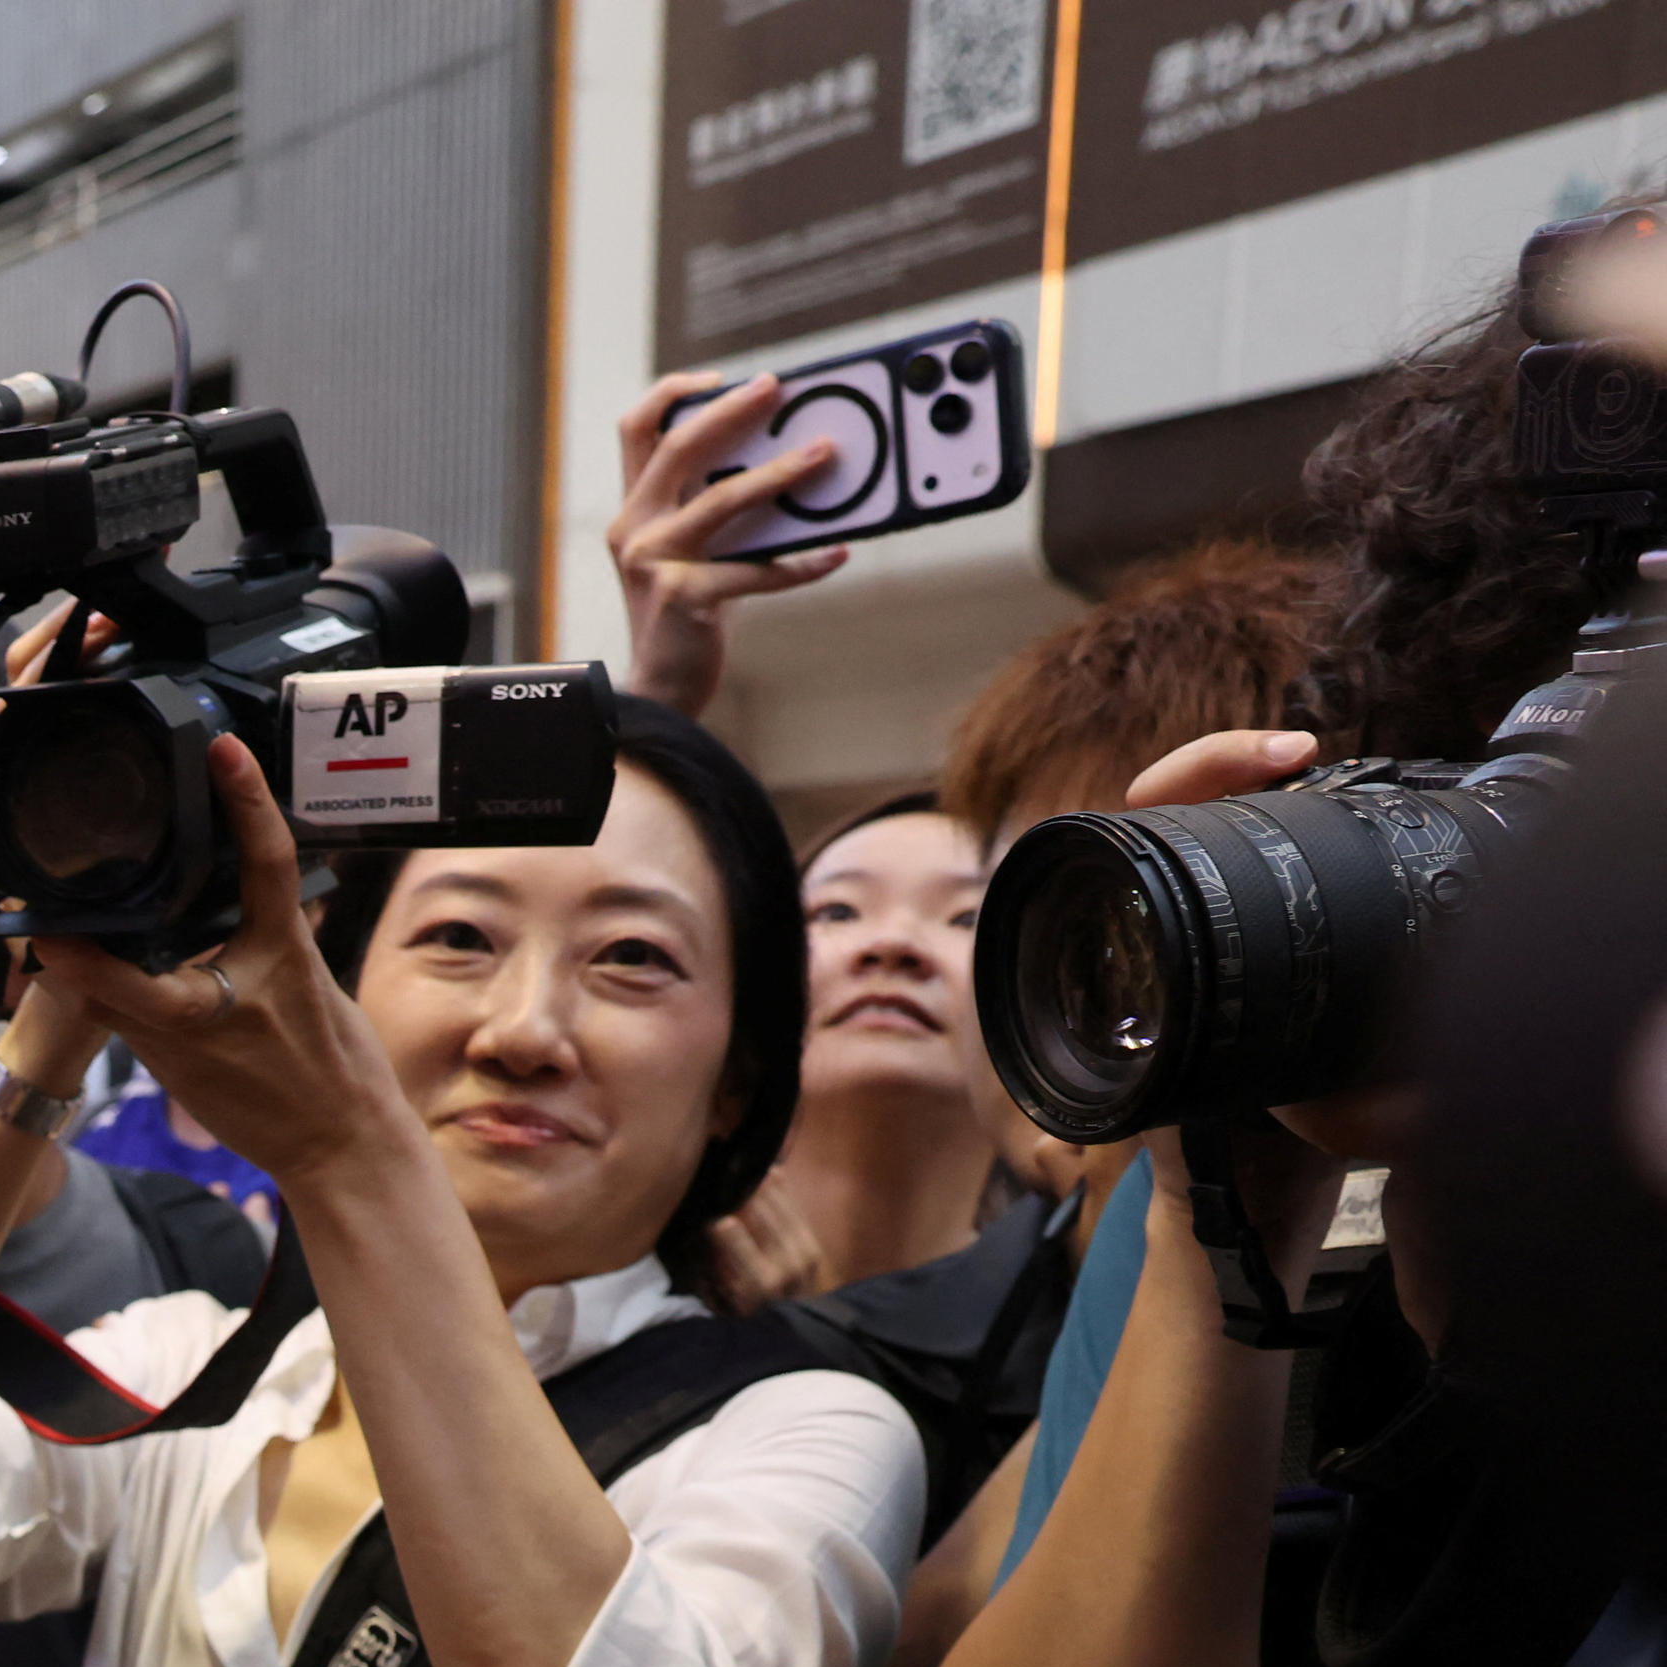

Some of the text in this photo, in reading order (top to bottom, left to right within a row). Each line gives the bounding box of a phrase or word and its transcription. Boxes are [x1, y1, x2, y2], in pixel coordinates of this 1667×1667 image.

[491, 682, 568, 700] SONY
[334, 691, 408, 738] AP
[1514, 705, 1586, 725] Nikon
[304, 795, 434, 812] ASSOCIATED PRESS
[1406, 918, 1417, 935] 70
